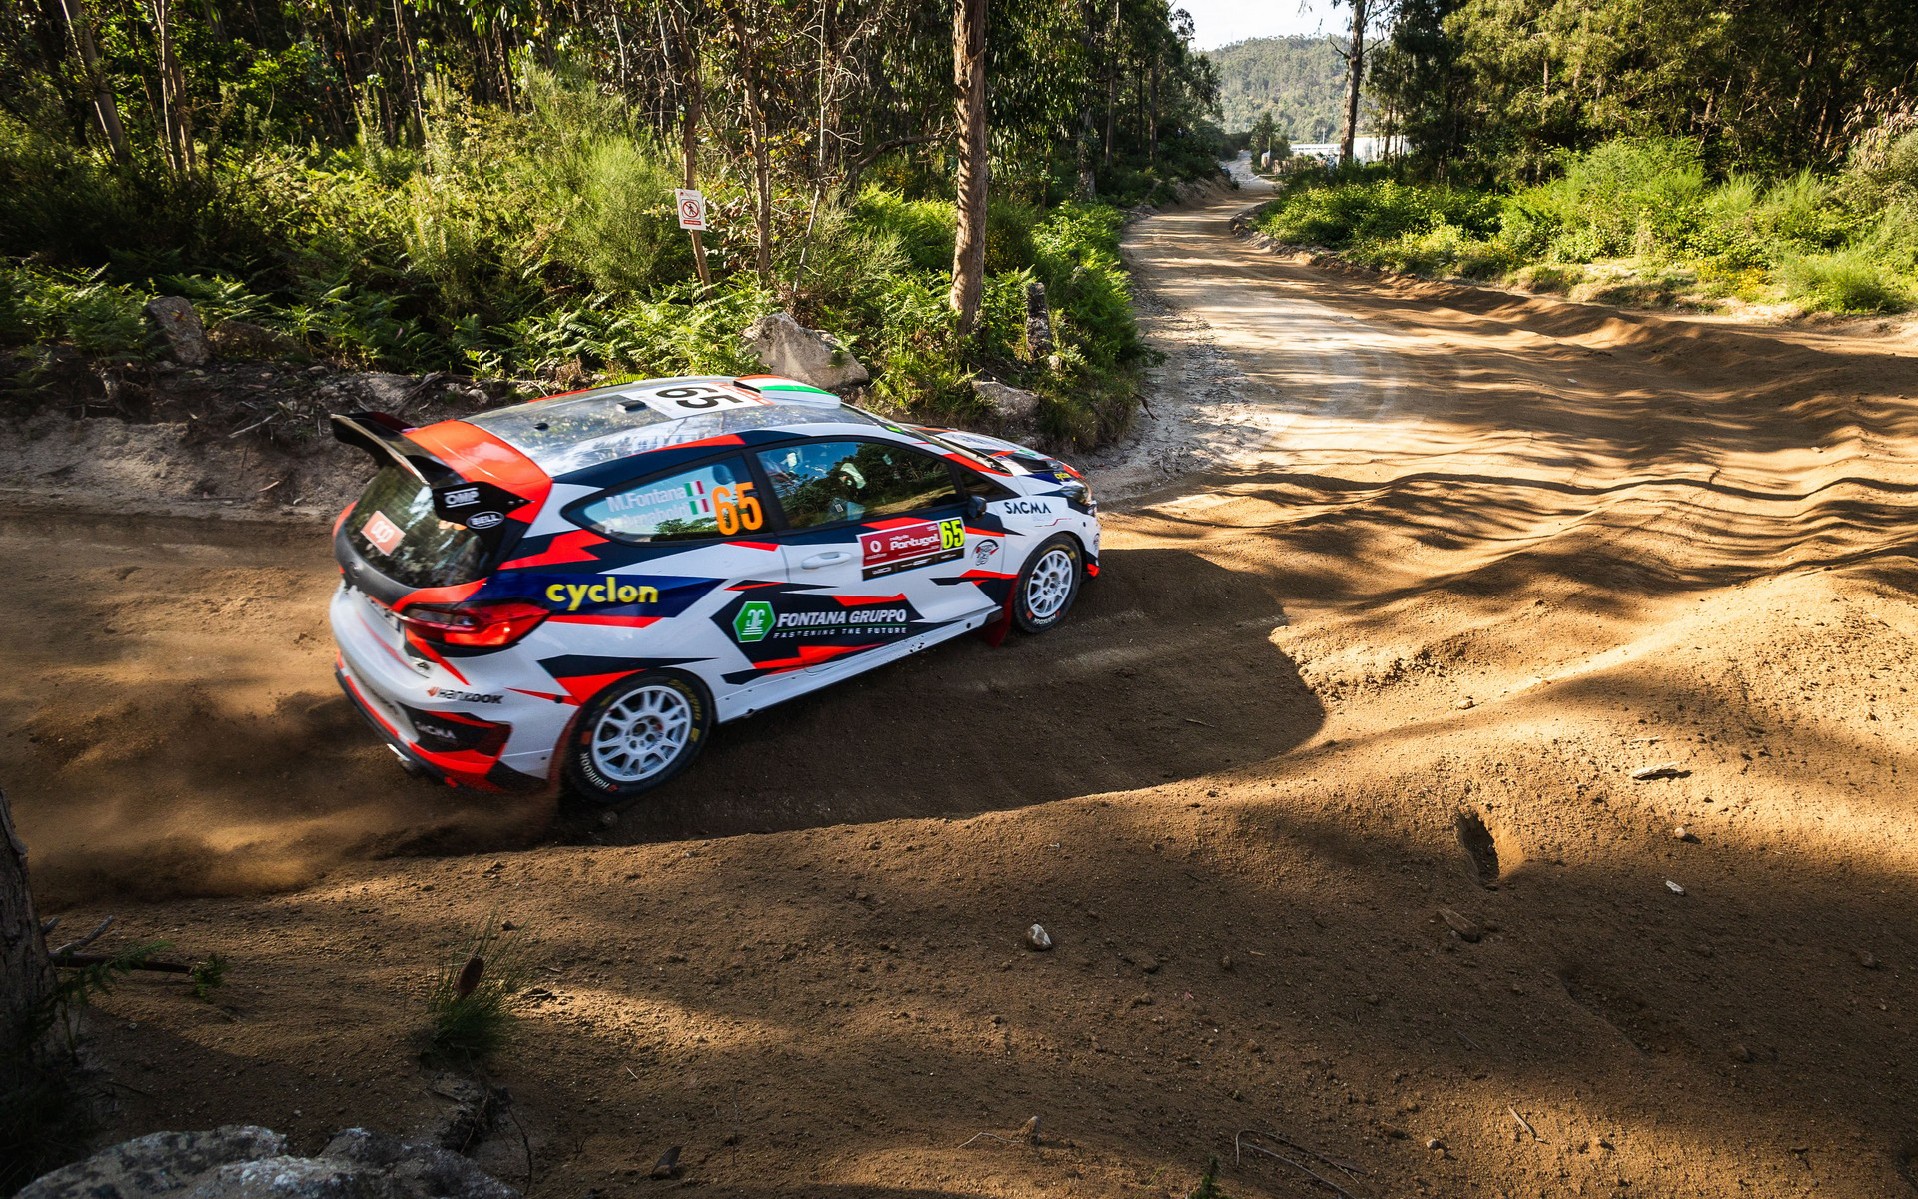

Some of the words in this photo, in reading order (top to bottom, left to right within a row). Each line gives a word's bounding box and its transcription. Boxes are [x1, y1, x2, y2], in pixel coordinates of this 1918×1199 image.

[656, 387, 744, 409] 65
[445, 488, 480, 505] OMP
[605, 485, 685, 513] M.Fontana
[712, 482, 763, 536] 65
[1004, 501, 1051, 514] SACMA
[471, 513, 501, 527] BELL
[890, 534, 940, 551] Portugal
[939, 520, 965, 550] 65
[545, 577, 659, 611] cyclon
[776, 611, 847, 628] FONTANA
[848, 608, 907, 624] GRUPPO
[773, 628, 836, 639] FASTENING
[841, 627, 861, 635] THE
[867, 627, 907, 635] FUTURE
